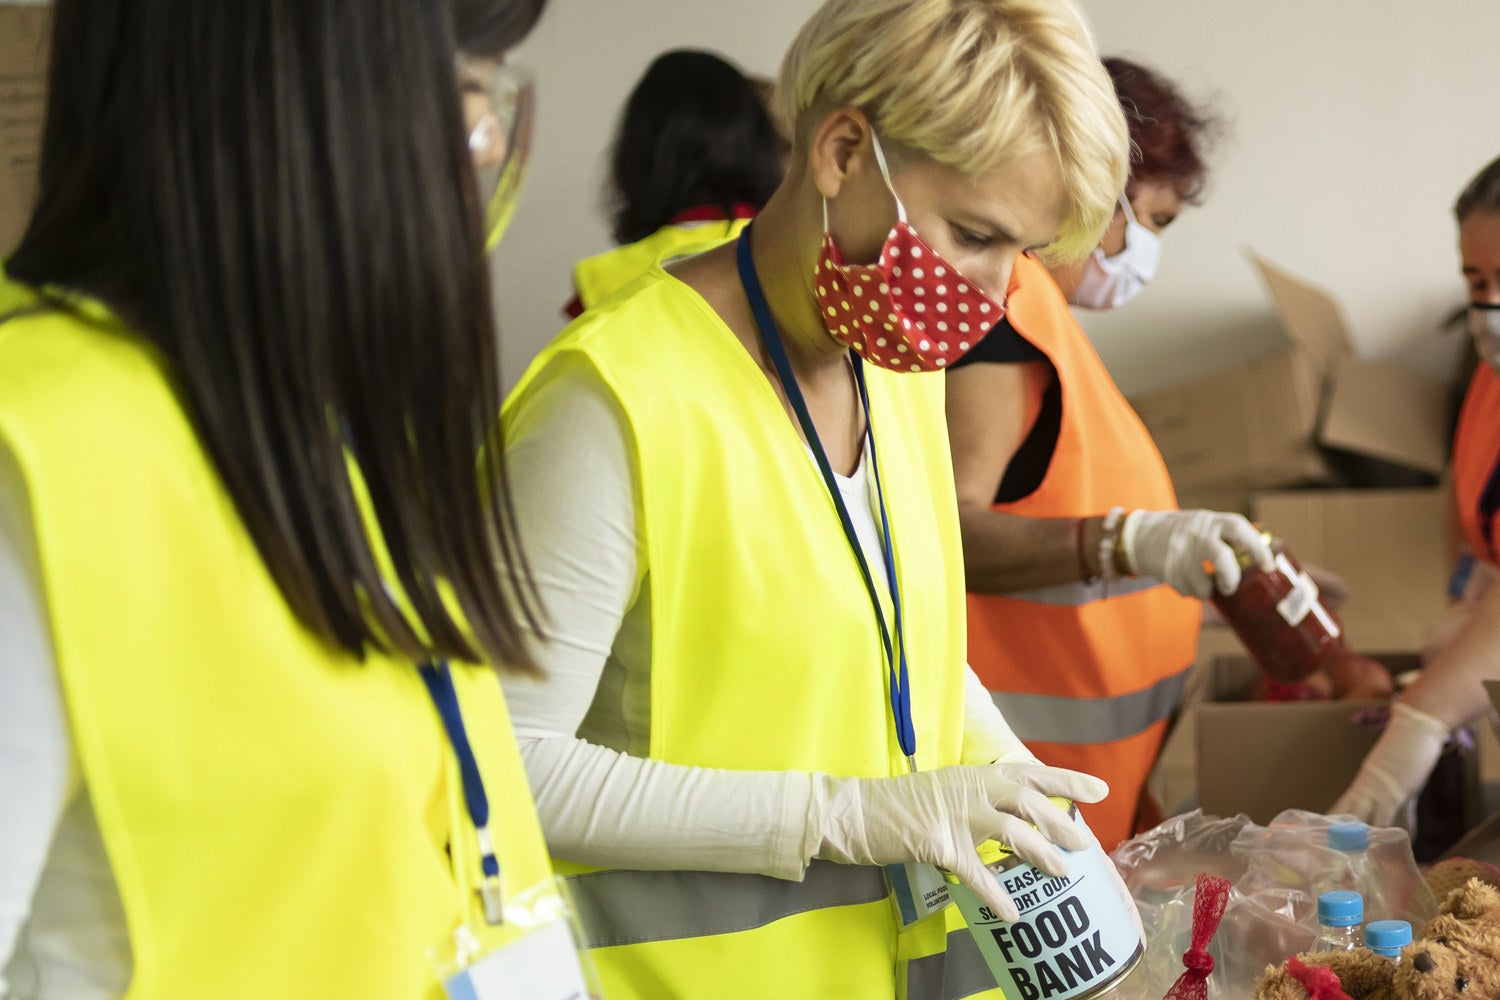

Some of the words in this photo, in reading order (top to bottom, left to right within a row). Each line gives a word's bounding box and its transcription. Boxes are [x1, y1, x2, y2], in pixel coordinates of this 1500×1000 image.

[979, 889, 1041, 920] SUORT
[1042, 873, 1071, 897] OUR
[1004, 867, 1043, 894] EASE
[990, 895, 1090, 963] FOOD
